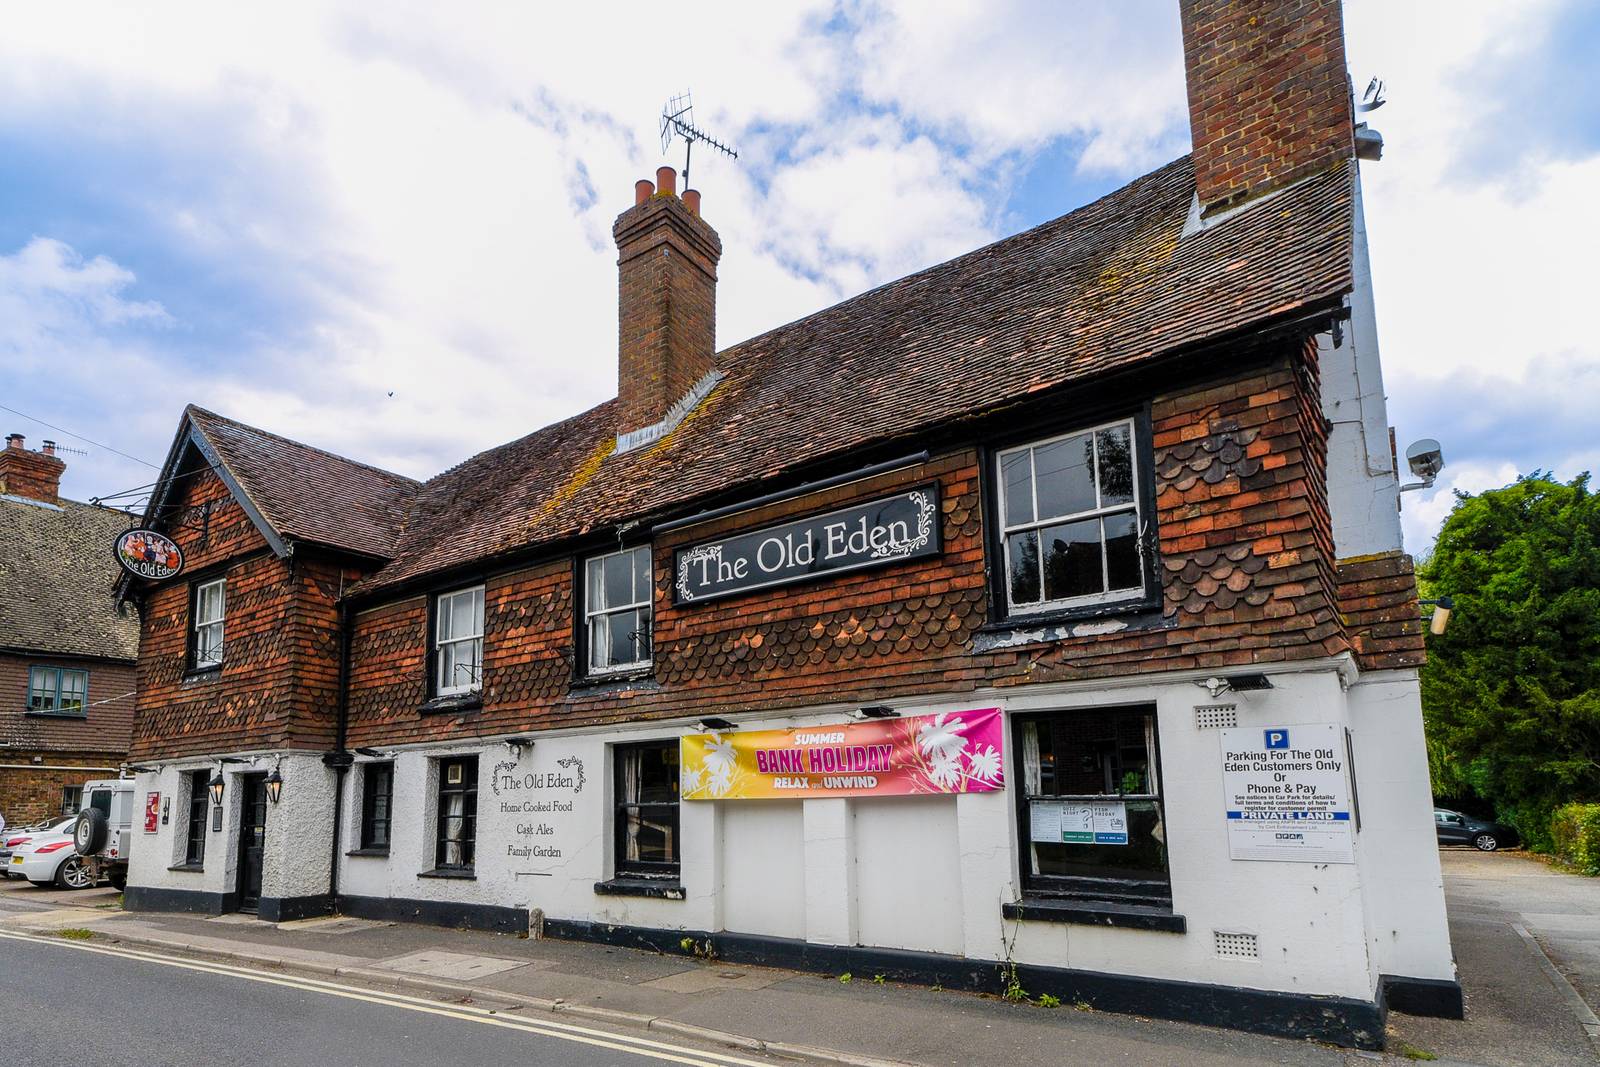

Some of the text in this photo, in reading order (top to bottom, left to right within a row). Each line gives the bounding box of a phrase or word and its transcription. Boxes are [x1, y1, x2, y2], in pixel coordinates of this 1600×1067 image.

[692, 516, 910, 586] The Old Eden
[125, 559, 176, 577] The Old Eden
[794, 732, 846, 745] SUMMER
[756, 744, 893, 774] BANK HOLIDAY
[1226, 749, 1333, 761] Parking For The Old
[1224, 760, 1341, 772] Eden Customers Only
[502, 773, 574, 790] The Old Eden
[774, 777, 809, 789] RELAX
[823, 776, 878, 788] UNWIND
[1273, 773, 1286, 782] Or
[1247, 783, 1317, 795] Phone & Pay
[500, 801, 573, 812] Home Cooked Food
[1240, 811, 1335, 820] PRIVATE LAND
[516, 823, 554, 835] Cask Ales
[507, 844, 561, 860] Family Garden
